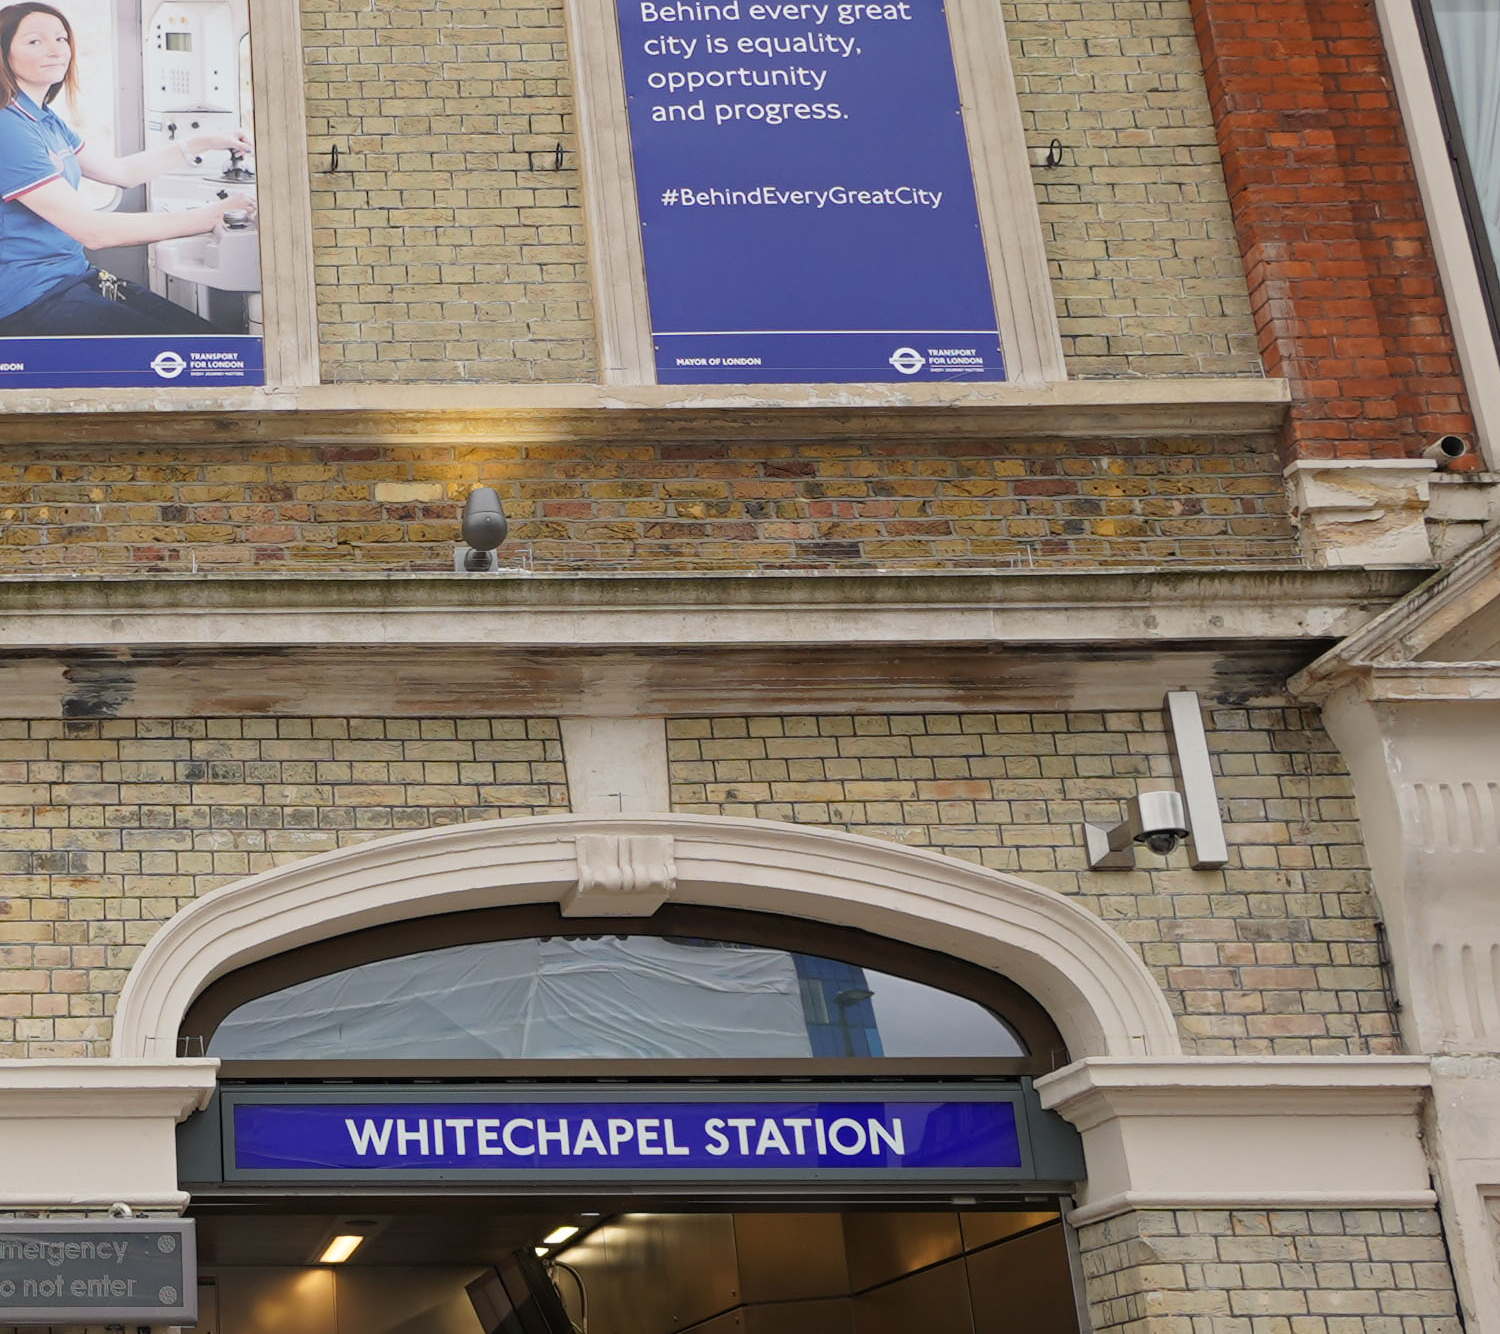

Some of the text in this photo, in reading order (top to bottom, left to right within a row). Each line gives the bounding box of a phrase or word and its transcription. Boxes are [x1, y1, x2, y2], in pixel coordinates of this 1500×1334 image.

[641, 1, 911, 24] Behind every great
[644, 33, 861, 59] city is equality,
[648, 67, 826, 92] opportunity
[653, 100, 848, 124] and progress.
[662, 187, 942, 208] #BehindEveryGreatCity
[190, 352, 238, 360] TRANSPORT
[676, 357, 762, 366] MAYOR OF LONDON
[345, 1118, 904, 1155] WHITECHAPEL STATION
[24, 1275, 64, 1297] not
[71, 1275, 136, 1297] enter
